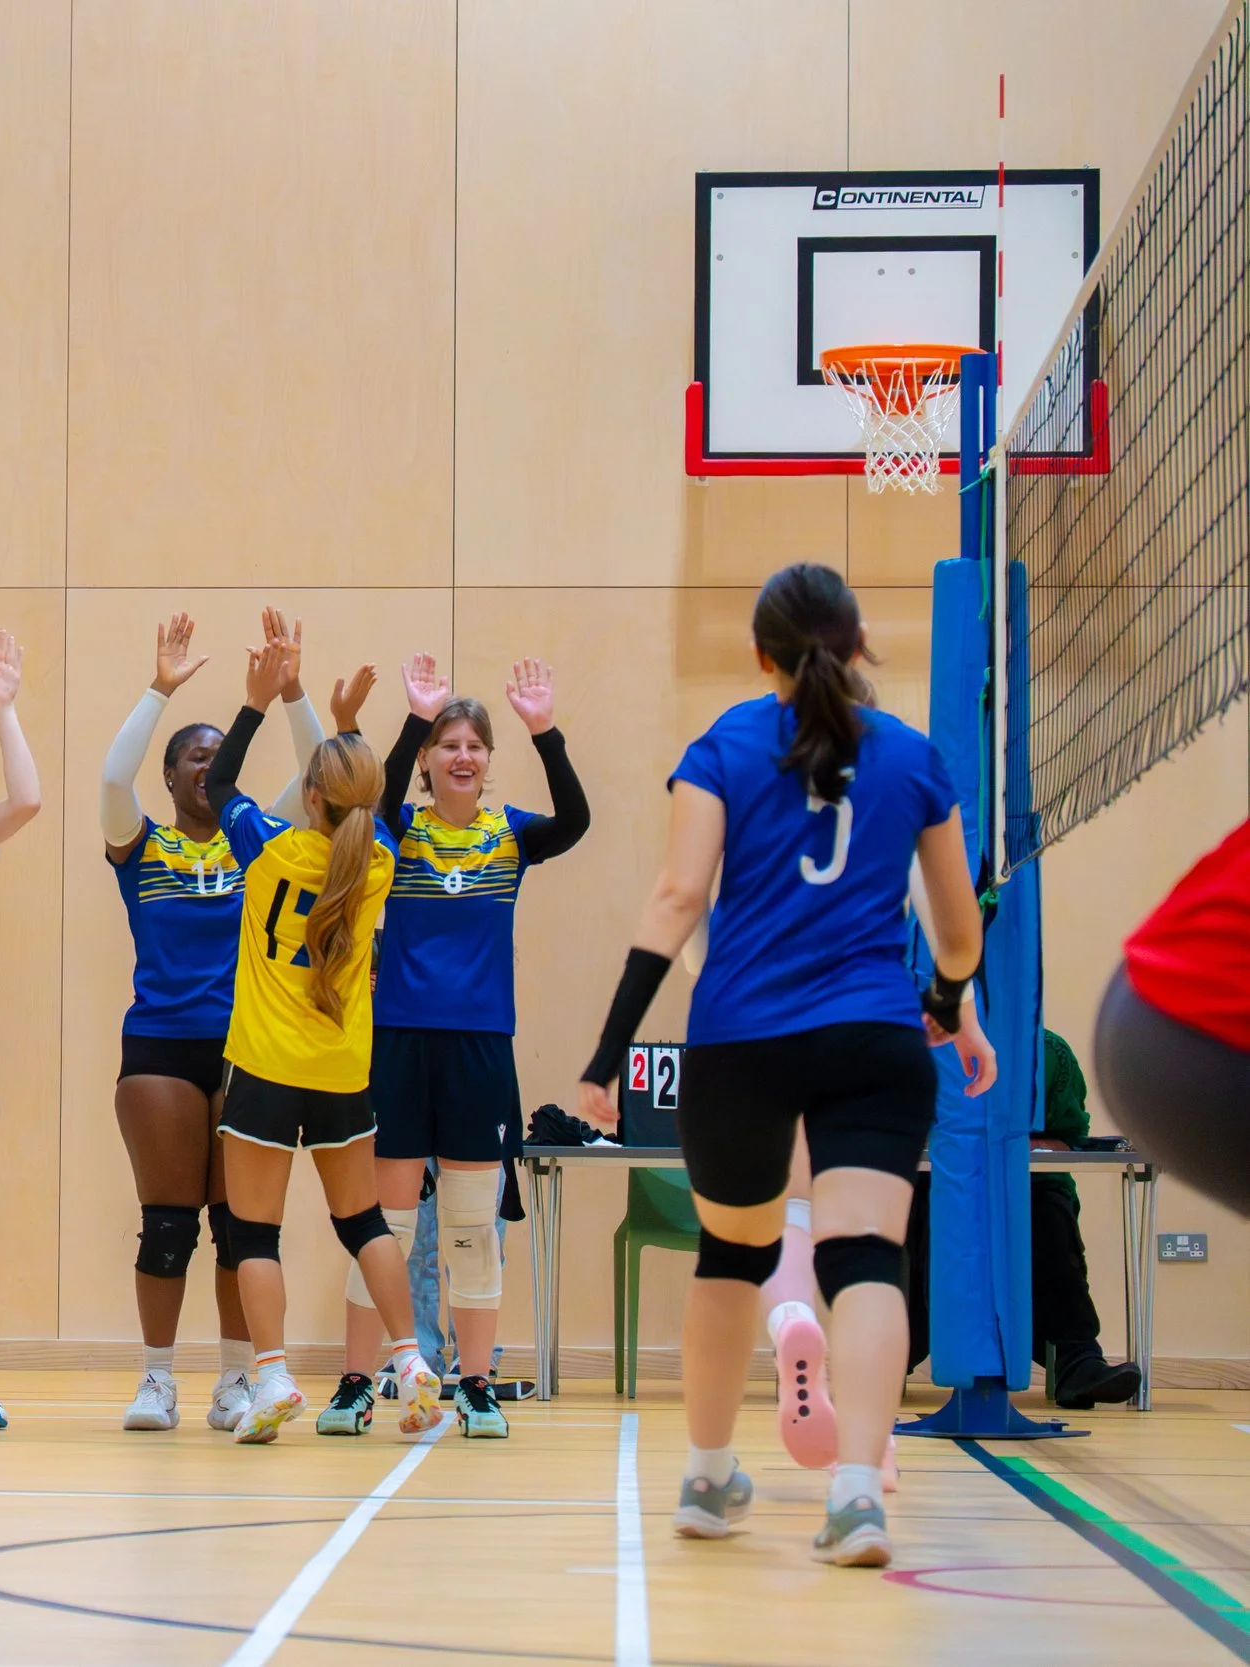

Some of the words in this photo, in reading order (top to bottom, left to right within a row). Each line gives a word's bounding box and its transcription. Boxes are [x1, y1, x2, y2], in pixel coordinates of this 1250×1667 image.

[816, 189, 979, 206] CONTINENTAL
[444, 865, 463, 895] 6
[632, 1052, 646, 1089] 2
[657, 1055, 677, 1107] 2
